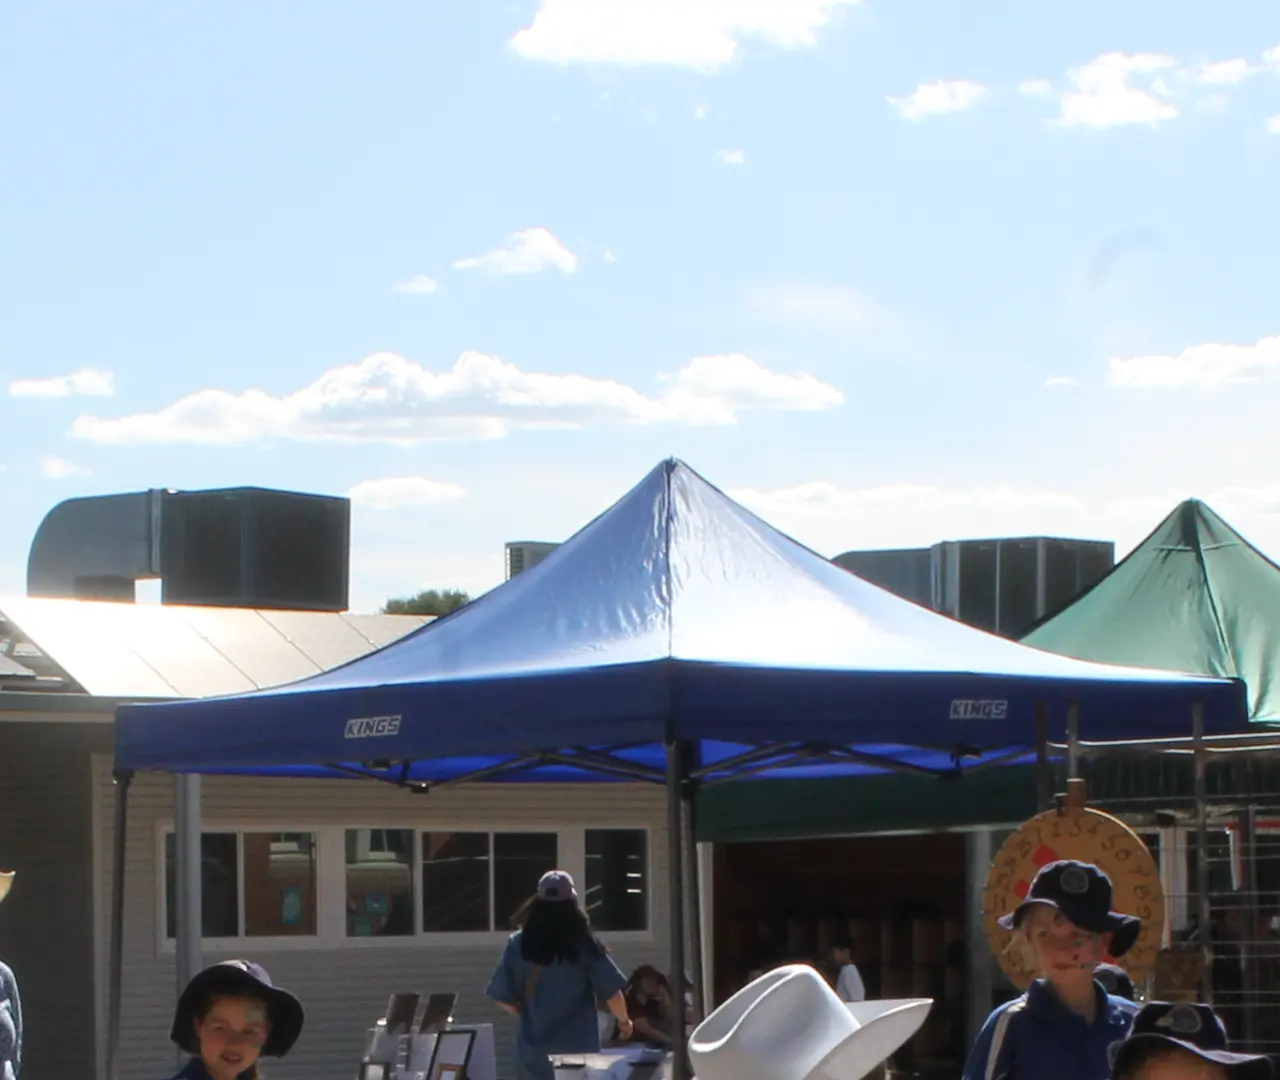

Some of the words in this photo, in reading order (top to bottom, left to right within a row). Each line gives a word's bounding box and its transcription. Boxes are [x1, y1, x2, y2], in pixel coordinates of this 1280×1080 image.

[949, 699, 1008, 719] KINGS
[344, 714, 402, 738] KINGS
[1052, 820, 1063, 838] 2
[1067, 820, 1082, 838] 3
[1116, 849, 1132, 862] 6
